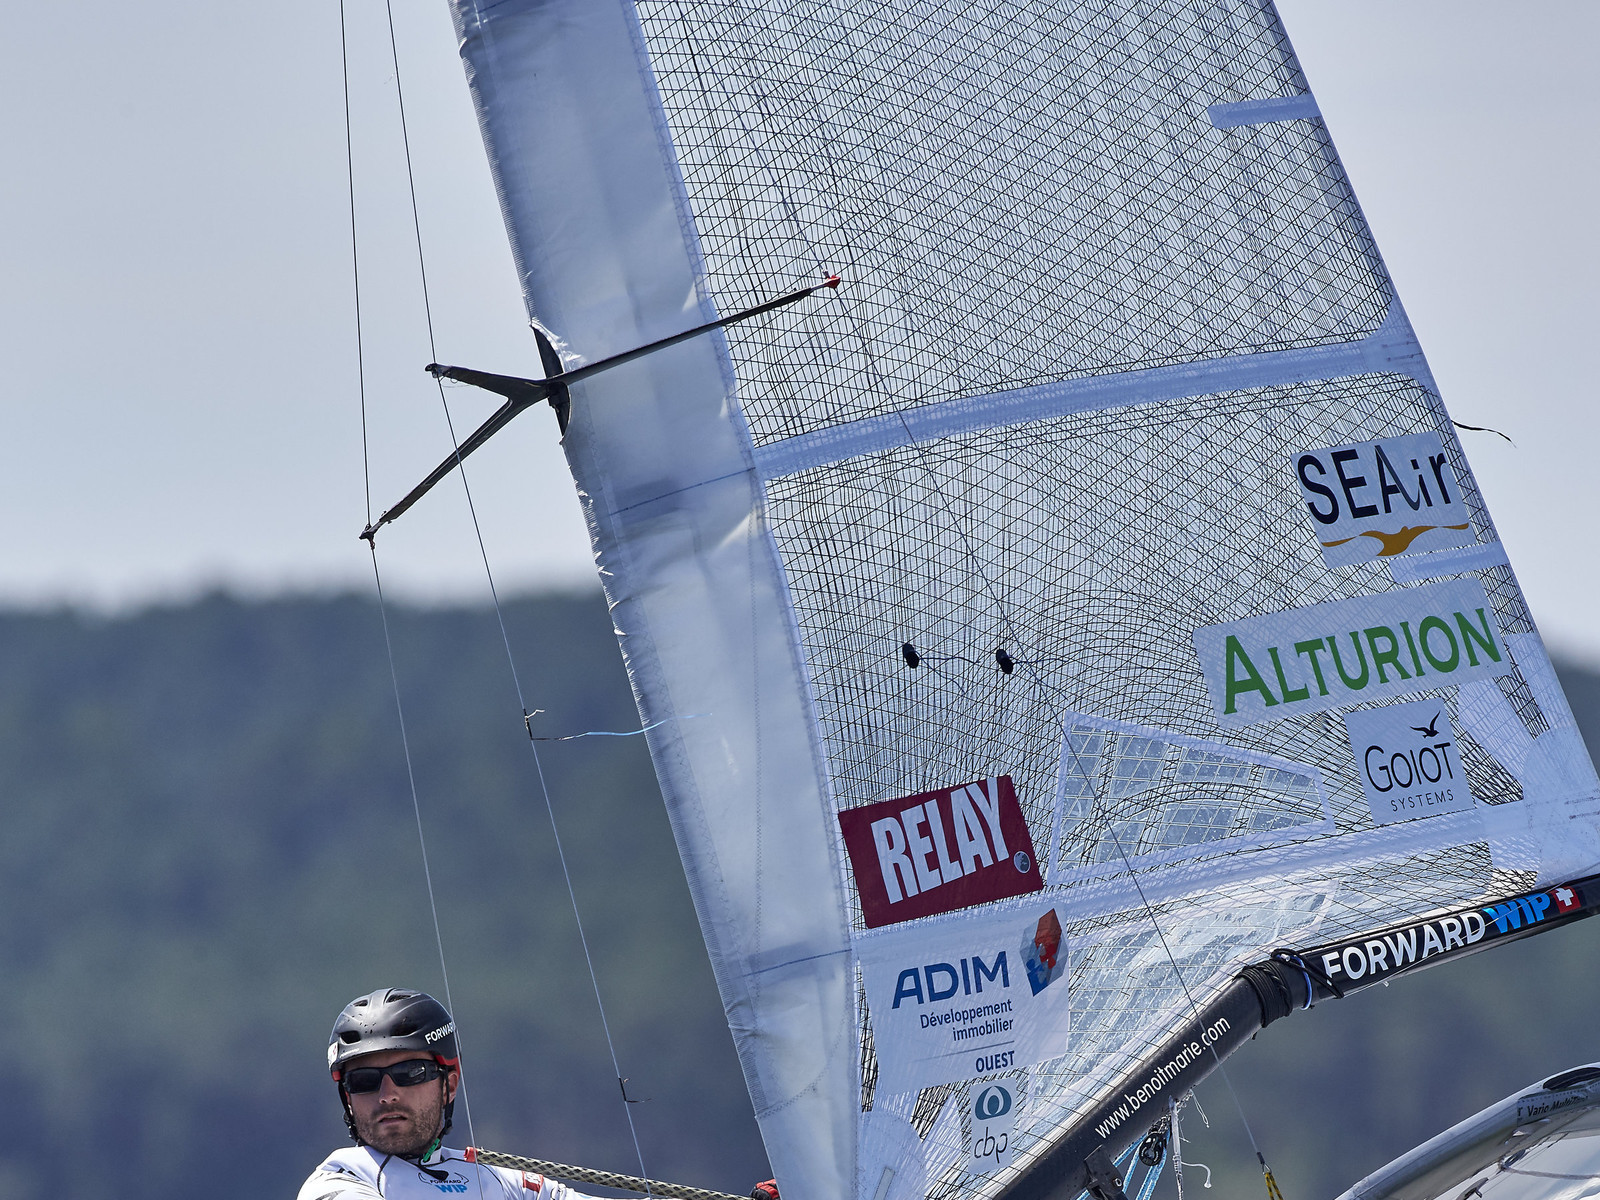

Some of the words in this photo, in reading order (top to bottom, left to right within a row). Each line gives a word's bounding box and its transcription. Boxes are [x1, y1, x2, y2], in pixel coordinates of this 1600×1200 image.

[1297, 444, 1452, 525] SEAir
[1223, 607, 1502, 715] ALTURION
[1390, 789, 1454, 812] SYSTEMS
[870, 777, 1010, 905] RELAY
[891, 951, 1011, 1010] ADIM
[919, 998, 1013, 1030] Développement
[952, 1016, 1014, 1042] immobilier
[975, 1051, 1015, 1073] OUEST
[1095, 1015, 1231, 1140] www.benoitmarie.com
[973, 1126, 1008, 1163] cbp
[434, 1184, 468, 1194] WIP
